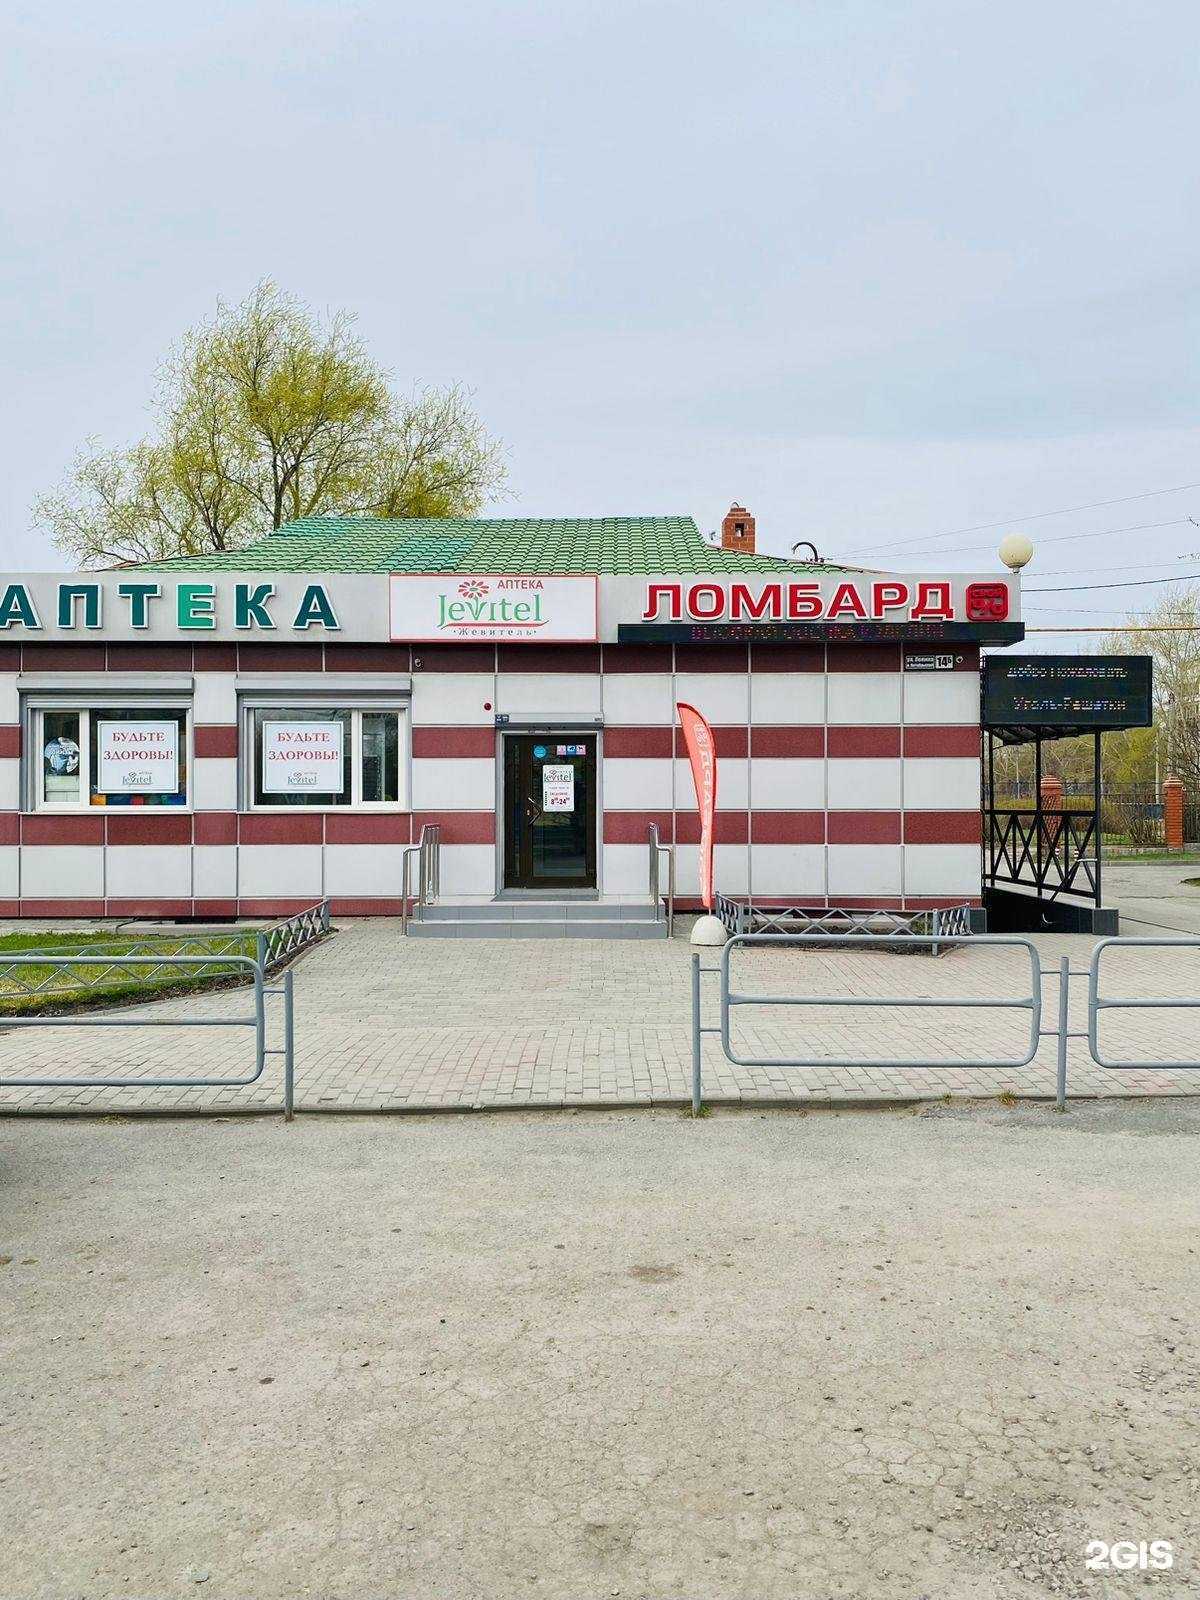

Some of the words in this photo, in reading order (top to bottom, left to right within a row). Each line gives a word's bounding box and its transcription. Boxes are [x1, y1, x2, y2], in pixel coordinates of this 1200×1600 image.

[497, 579, 544, 590] АПТЕКА
[641, 580, 955, 622] ЛОМБАРД
[0, 583, 342, 630] АПТЕКА
[435, 593, 544, 628] Jevitel
[112, 732, 165, 742] БУДЬТЕ
[277, 732, 330, 742] БУДЬТЕ
[103, 750, 174, 760] ЗДОРОВЫ!
[268, 750, 339, 760] ЗДОРОВЫ!
